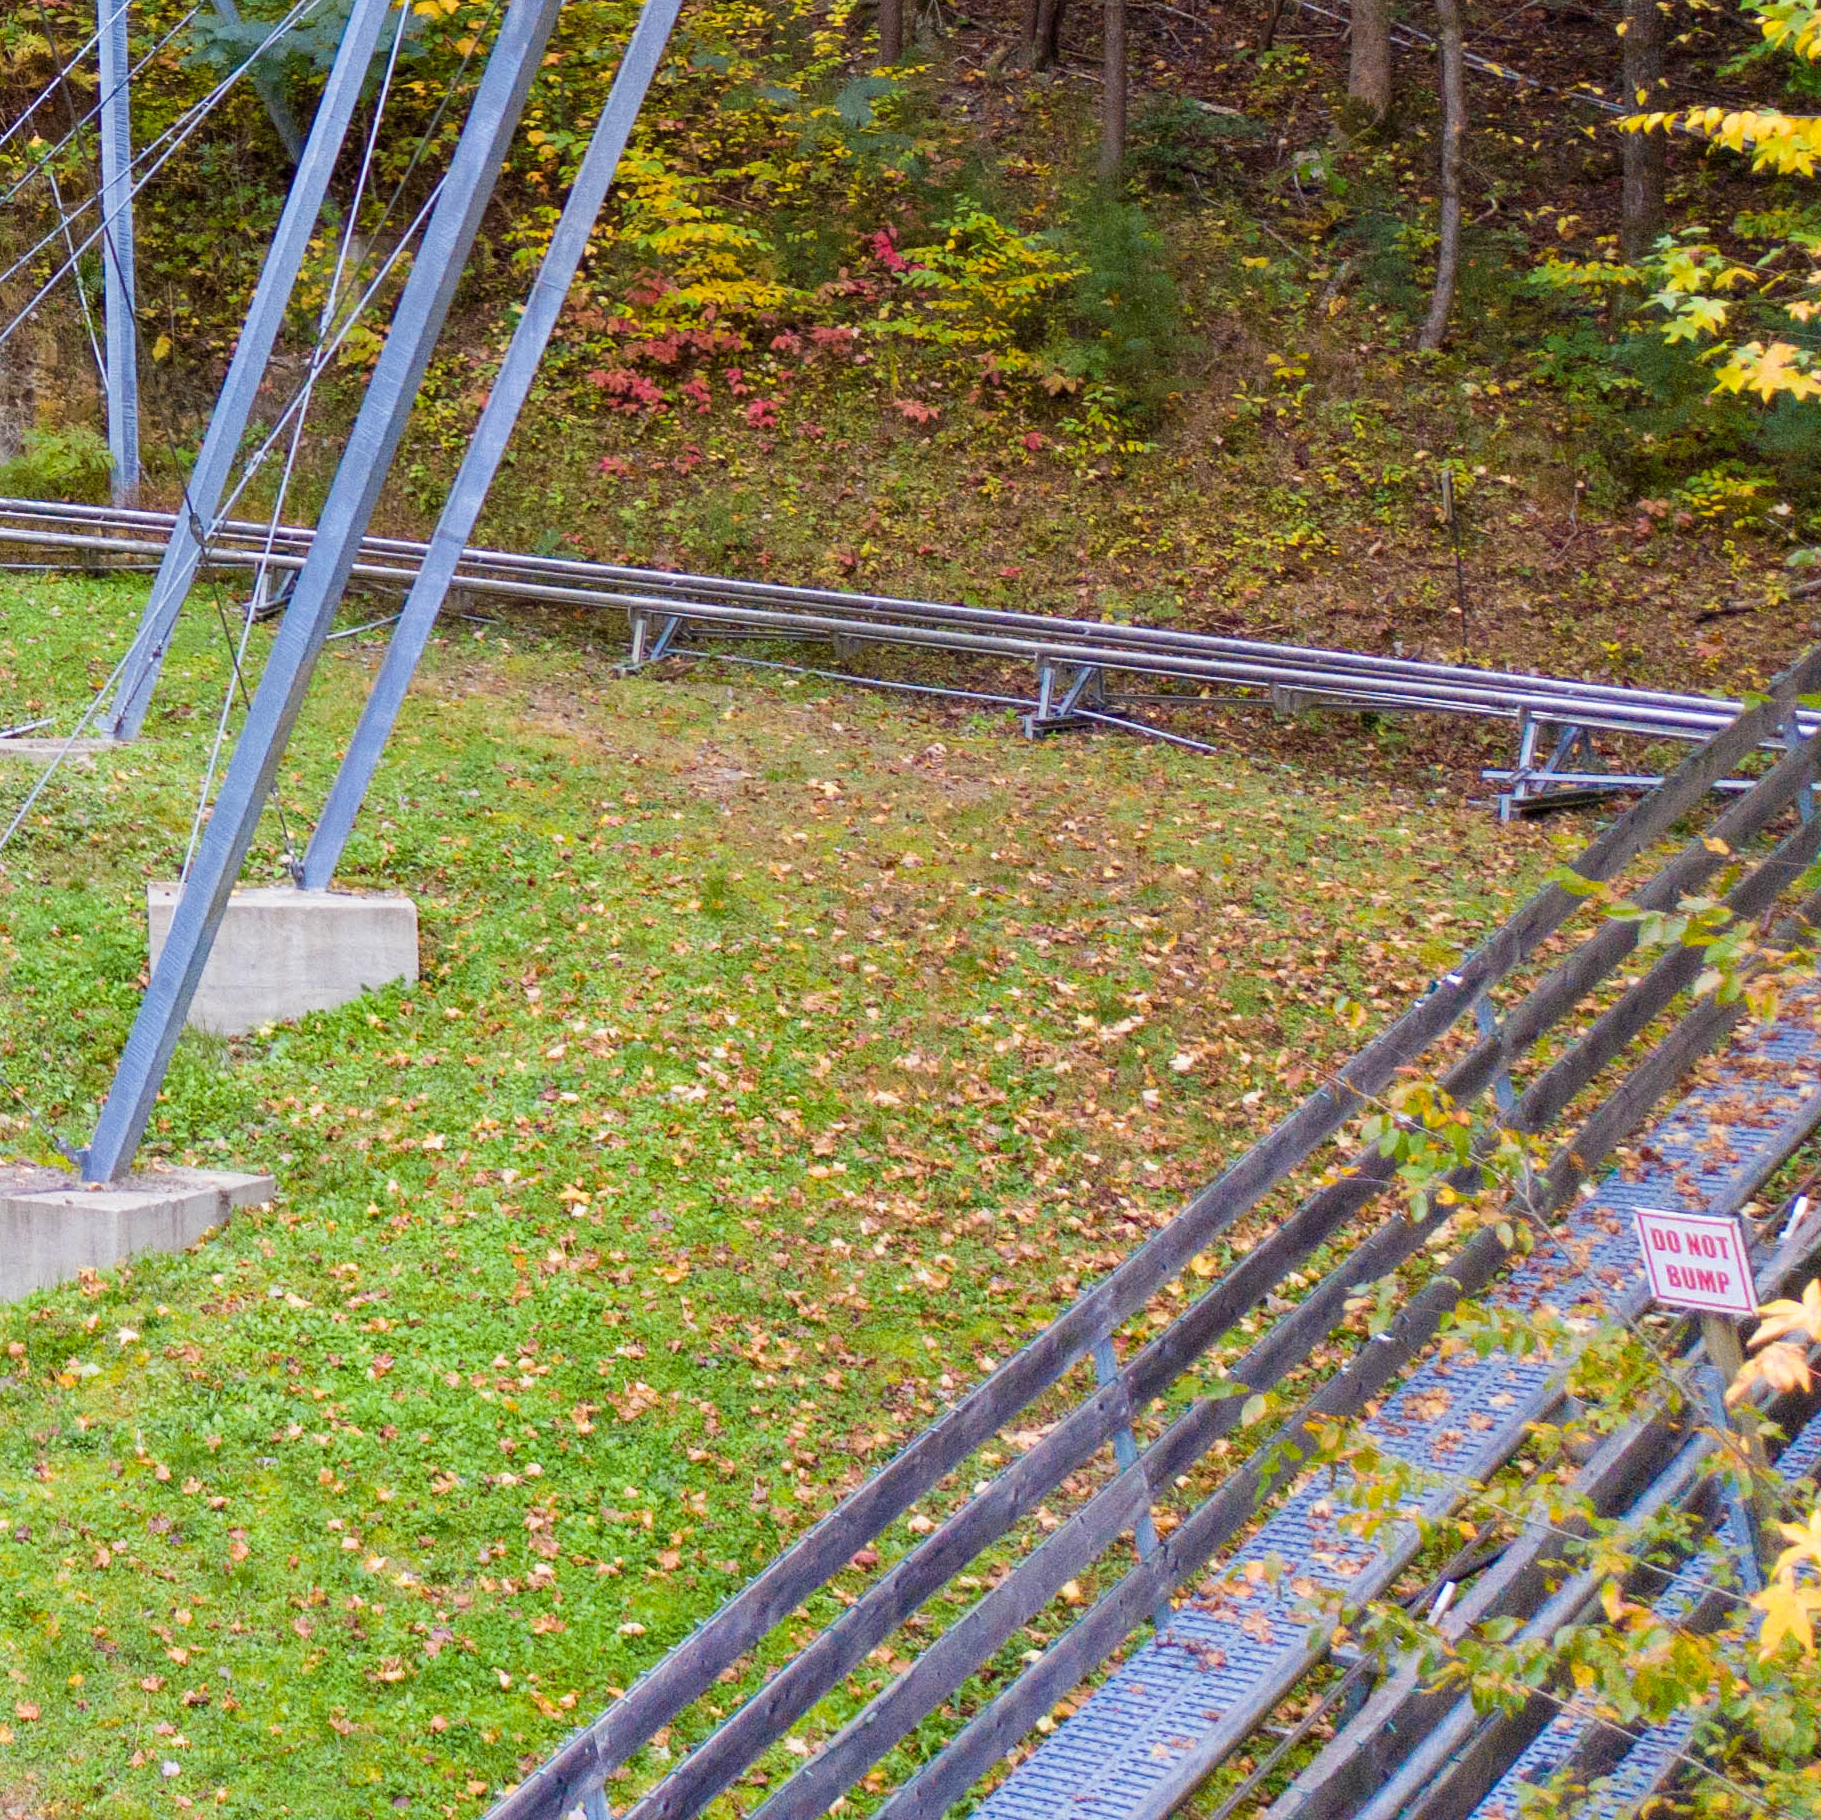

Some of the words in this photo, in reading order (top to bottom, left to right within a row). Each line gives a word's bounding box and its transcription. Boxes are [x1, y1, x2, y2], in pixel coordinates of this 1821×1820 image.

[1651, 1228, 1681, 1254] DO
[1686, 1233, 1729, 1260] NOT
[1666, 1265, 1731, 1294] BUMP
